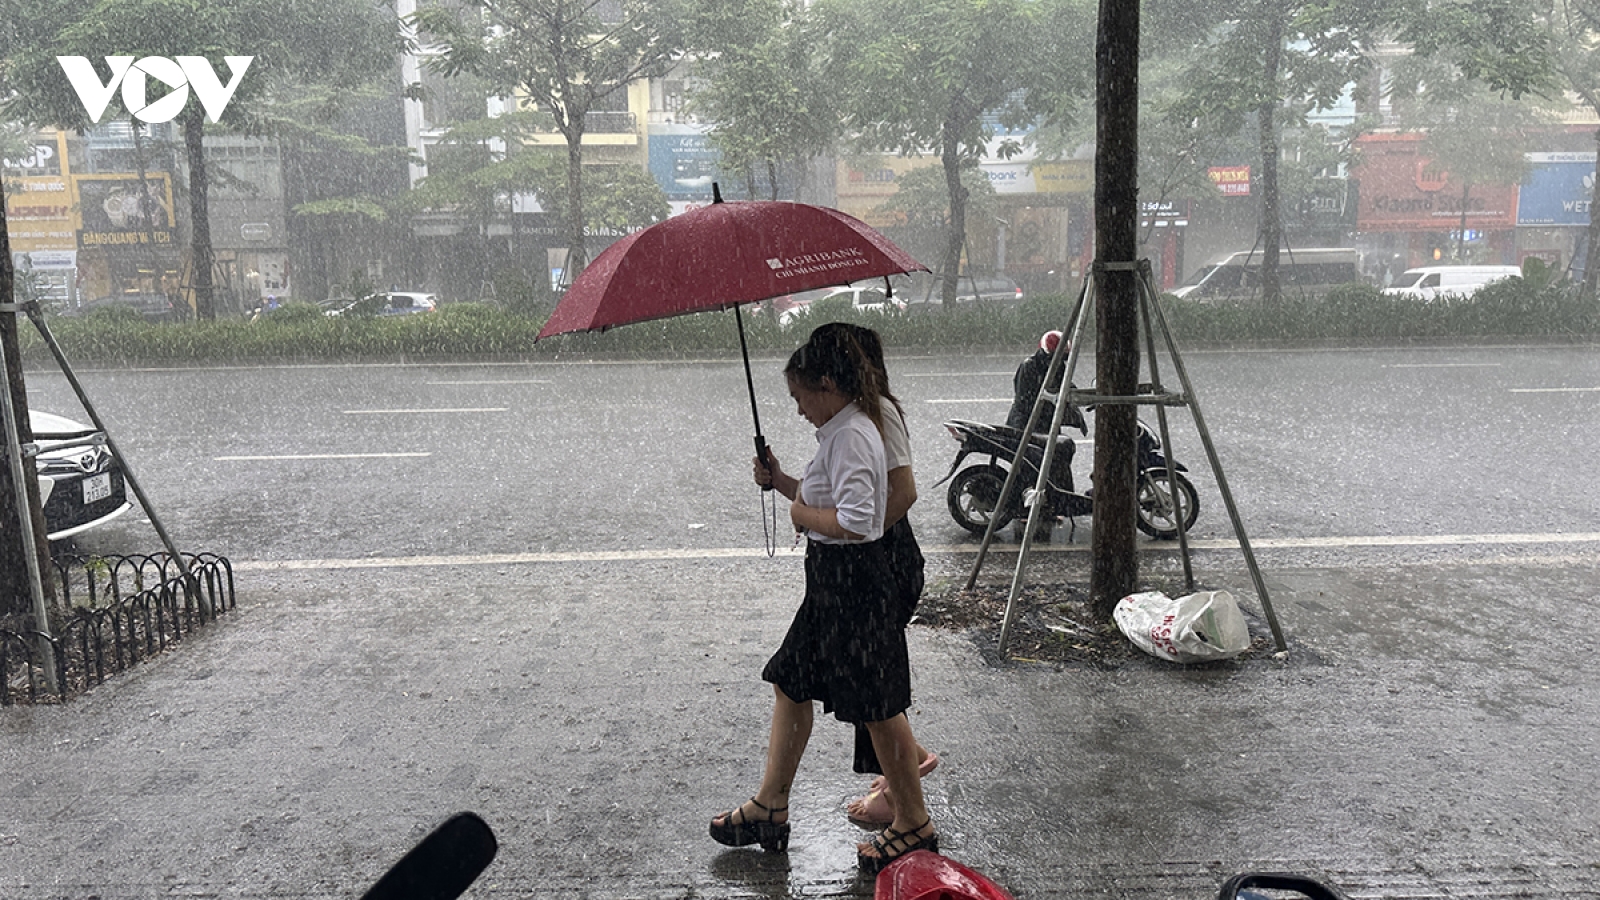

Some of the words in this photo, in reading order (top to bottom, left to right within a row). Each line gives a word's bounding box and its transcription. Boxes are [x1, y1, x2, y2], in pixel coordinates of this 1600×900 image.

[138, 231, 170, 244] WTCH
[784, 246, 864, 268] AGRIBANK
[776, 270, 795, 279] CHI
[793, 263, 828, 277] NHANH
